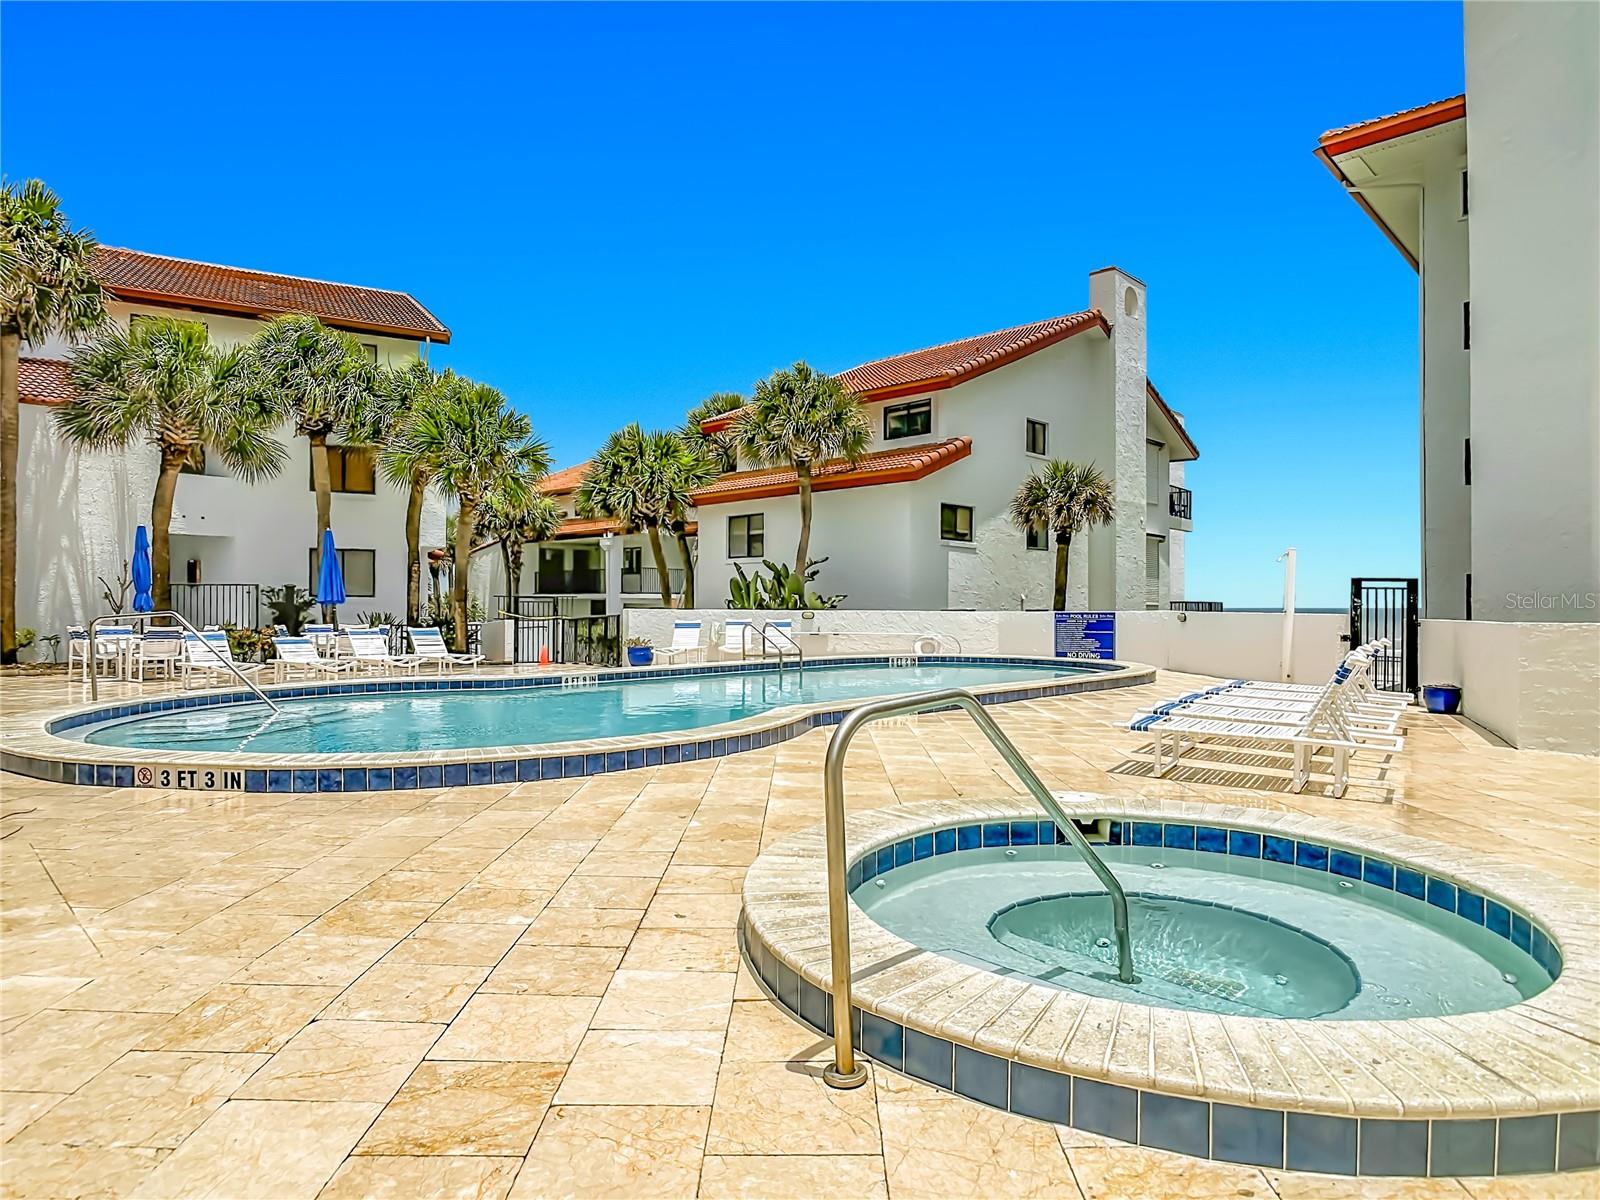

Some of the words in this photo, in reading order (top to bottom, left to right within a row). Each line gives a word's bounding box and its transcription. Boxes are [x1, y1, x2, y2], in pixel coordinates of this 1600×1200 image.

[160, 770, 171, 787] 3
[204, 771, 215, 788] 3
[223, 771, 242, 789] IN
